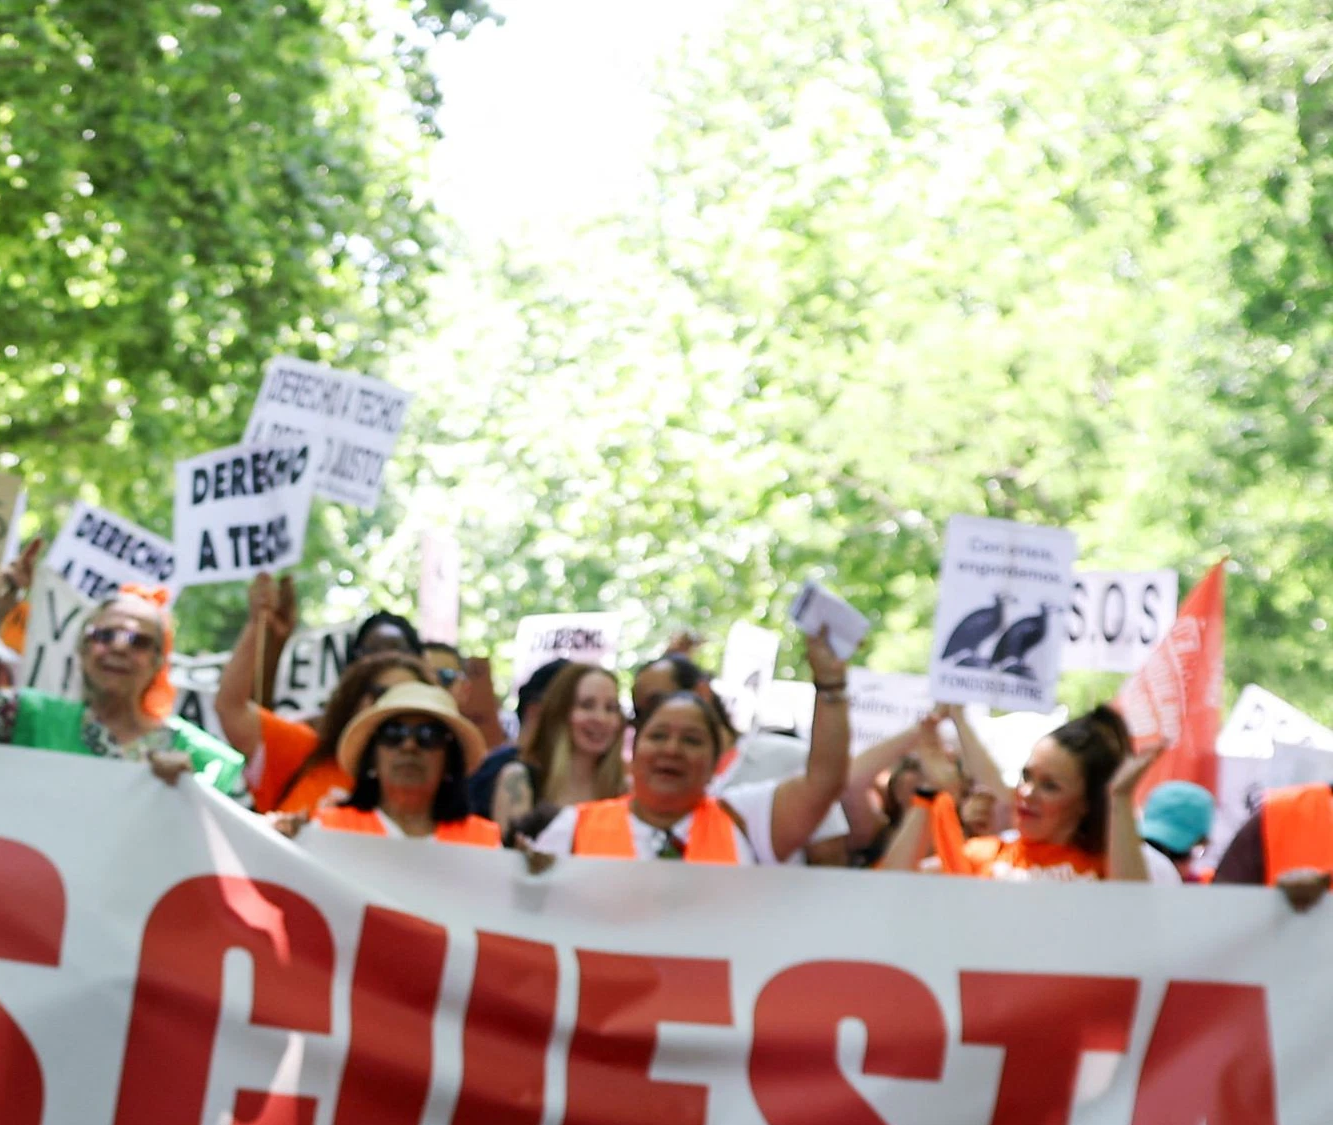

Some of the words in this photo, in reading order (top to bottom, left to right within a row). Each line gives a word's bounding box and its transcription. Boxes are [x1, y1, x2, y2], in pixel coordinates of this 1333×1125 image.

[192, 445, 309, 506] DERECHO
[75, 512, 177, 582] DERECHO
[198, 530, 219, 572] A
